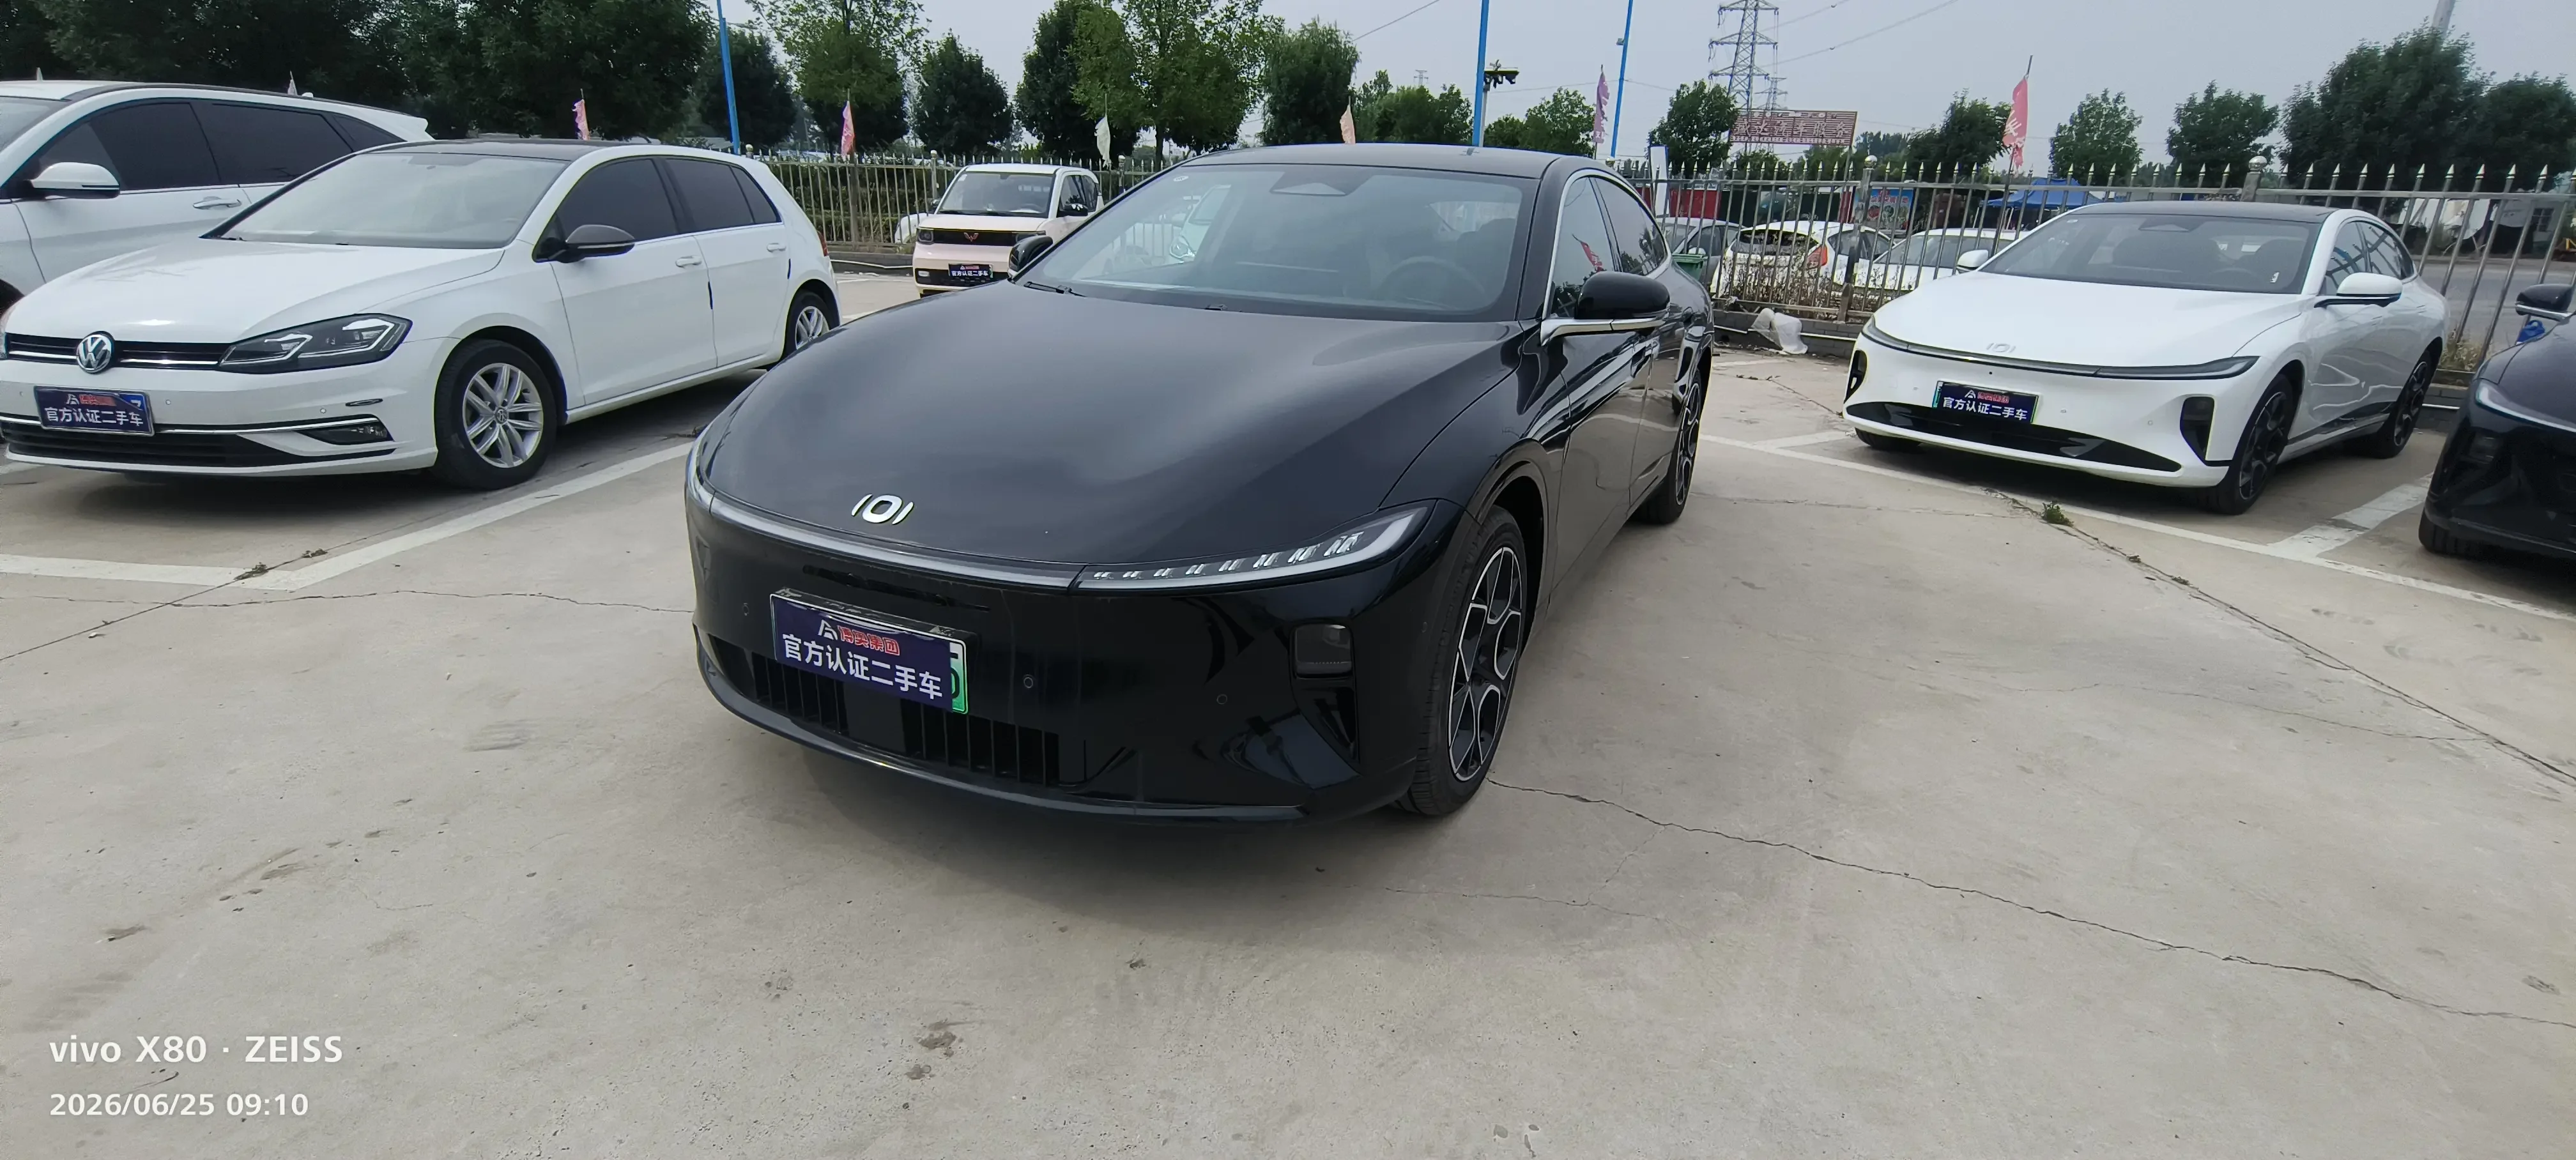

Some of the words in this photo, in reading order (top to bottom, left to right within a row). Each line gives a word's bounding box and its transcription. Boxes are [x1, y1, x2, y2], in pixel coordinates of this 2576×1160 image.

[44, 406, 144, 426] 官方认证二手车
[1943, 397, 2028, 420] 官方认证二手车
[782, 634, 943, 700] 官方认证二手车
